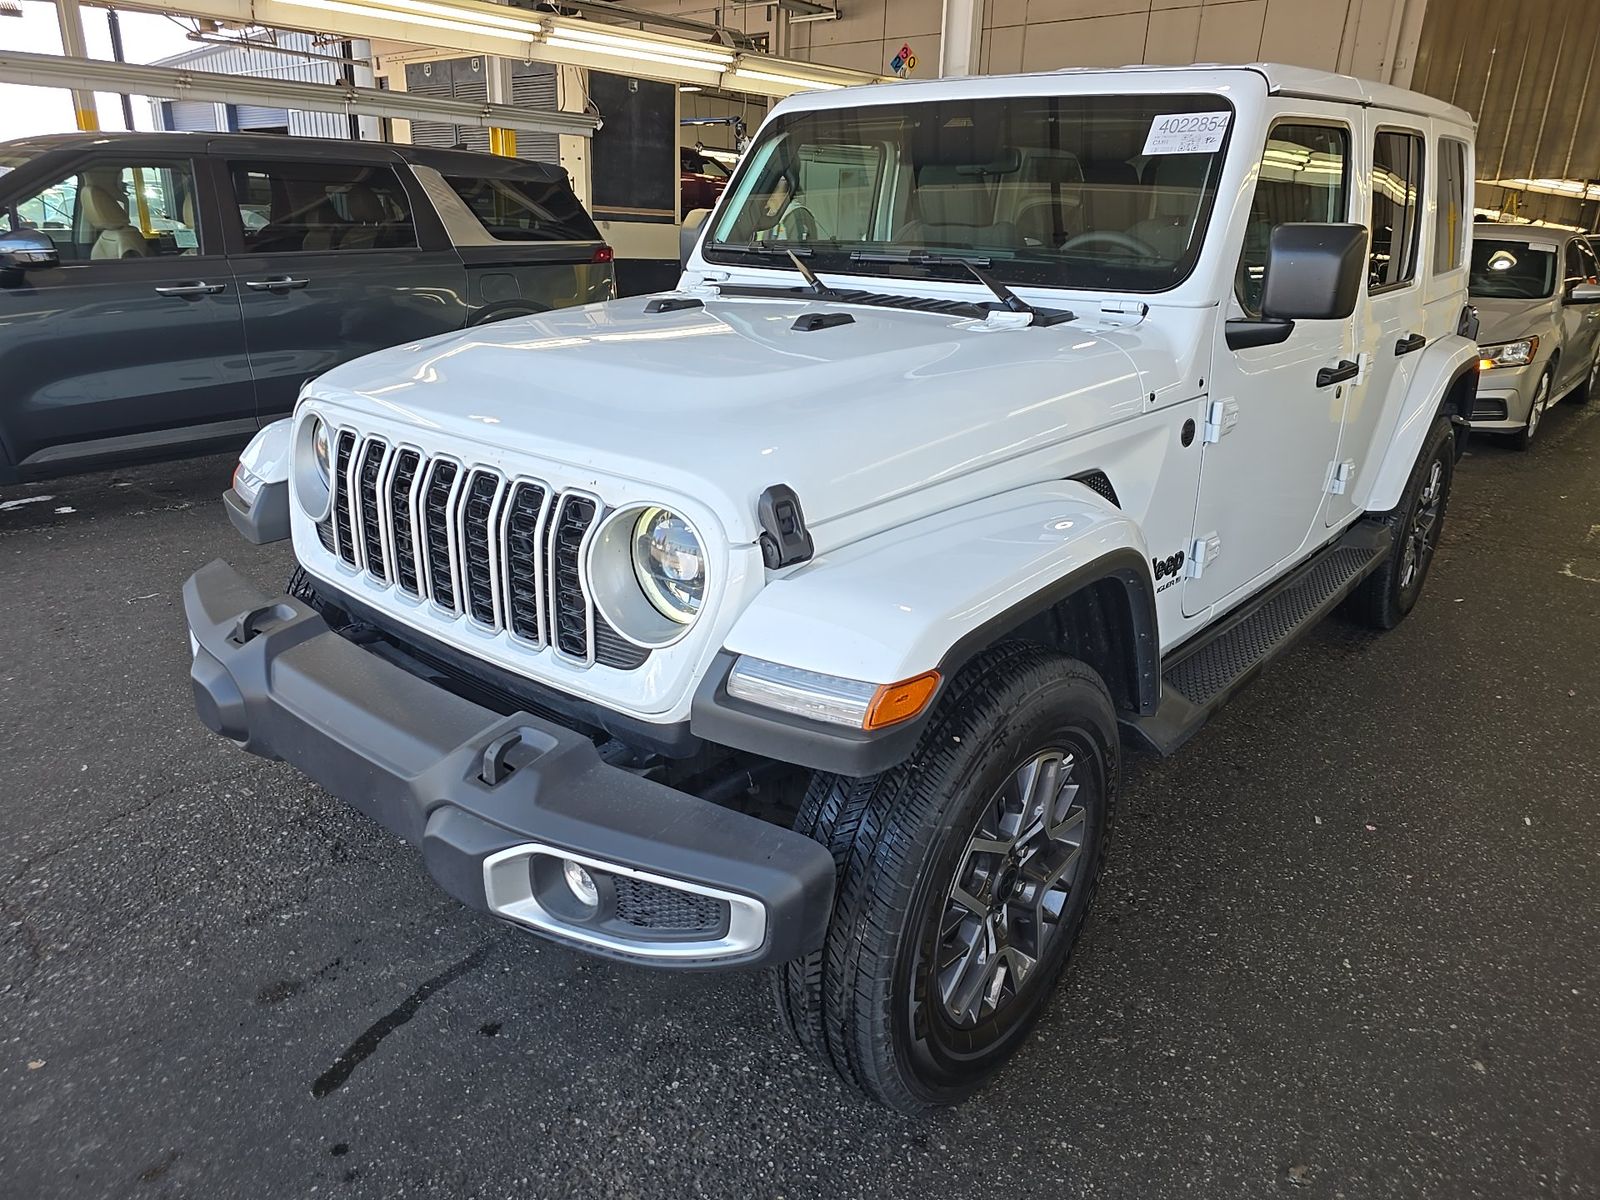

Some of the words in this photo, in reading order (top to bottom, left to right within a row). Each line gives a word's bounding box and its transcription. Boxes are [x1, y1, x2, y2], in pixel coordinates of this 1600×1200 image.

[901, 46, 909, 59] 3
[894, 56, 902, 69] 2
[908, 56, 916, 69] 0
[1159, 116, 1228, 134] 4022854
